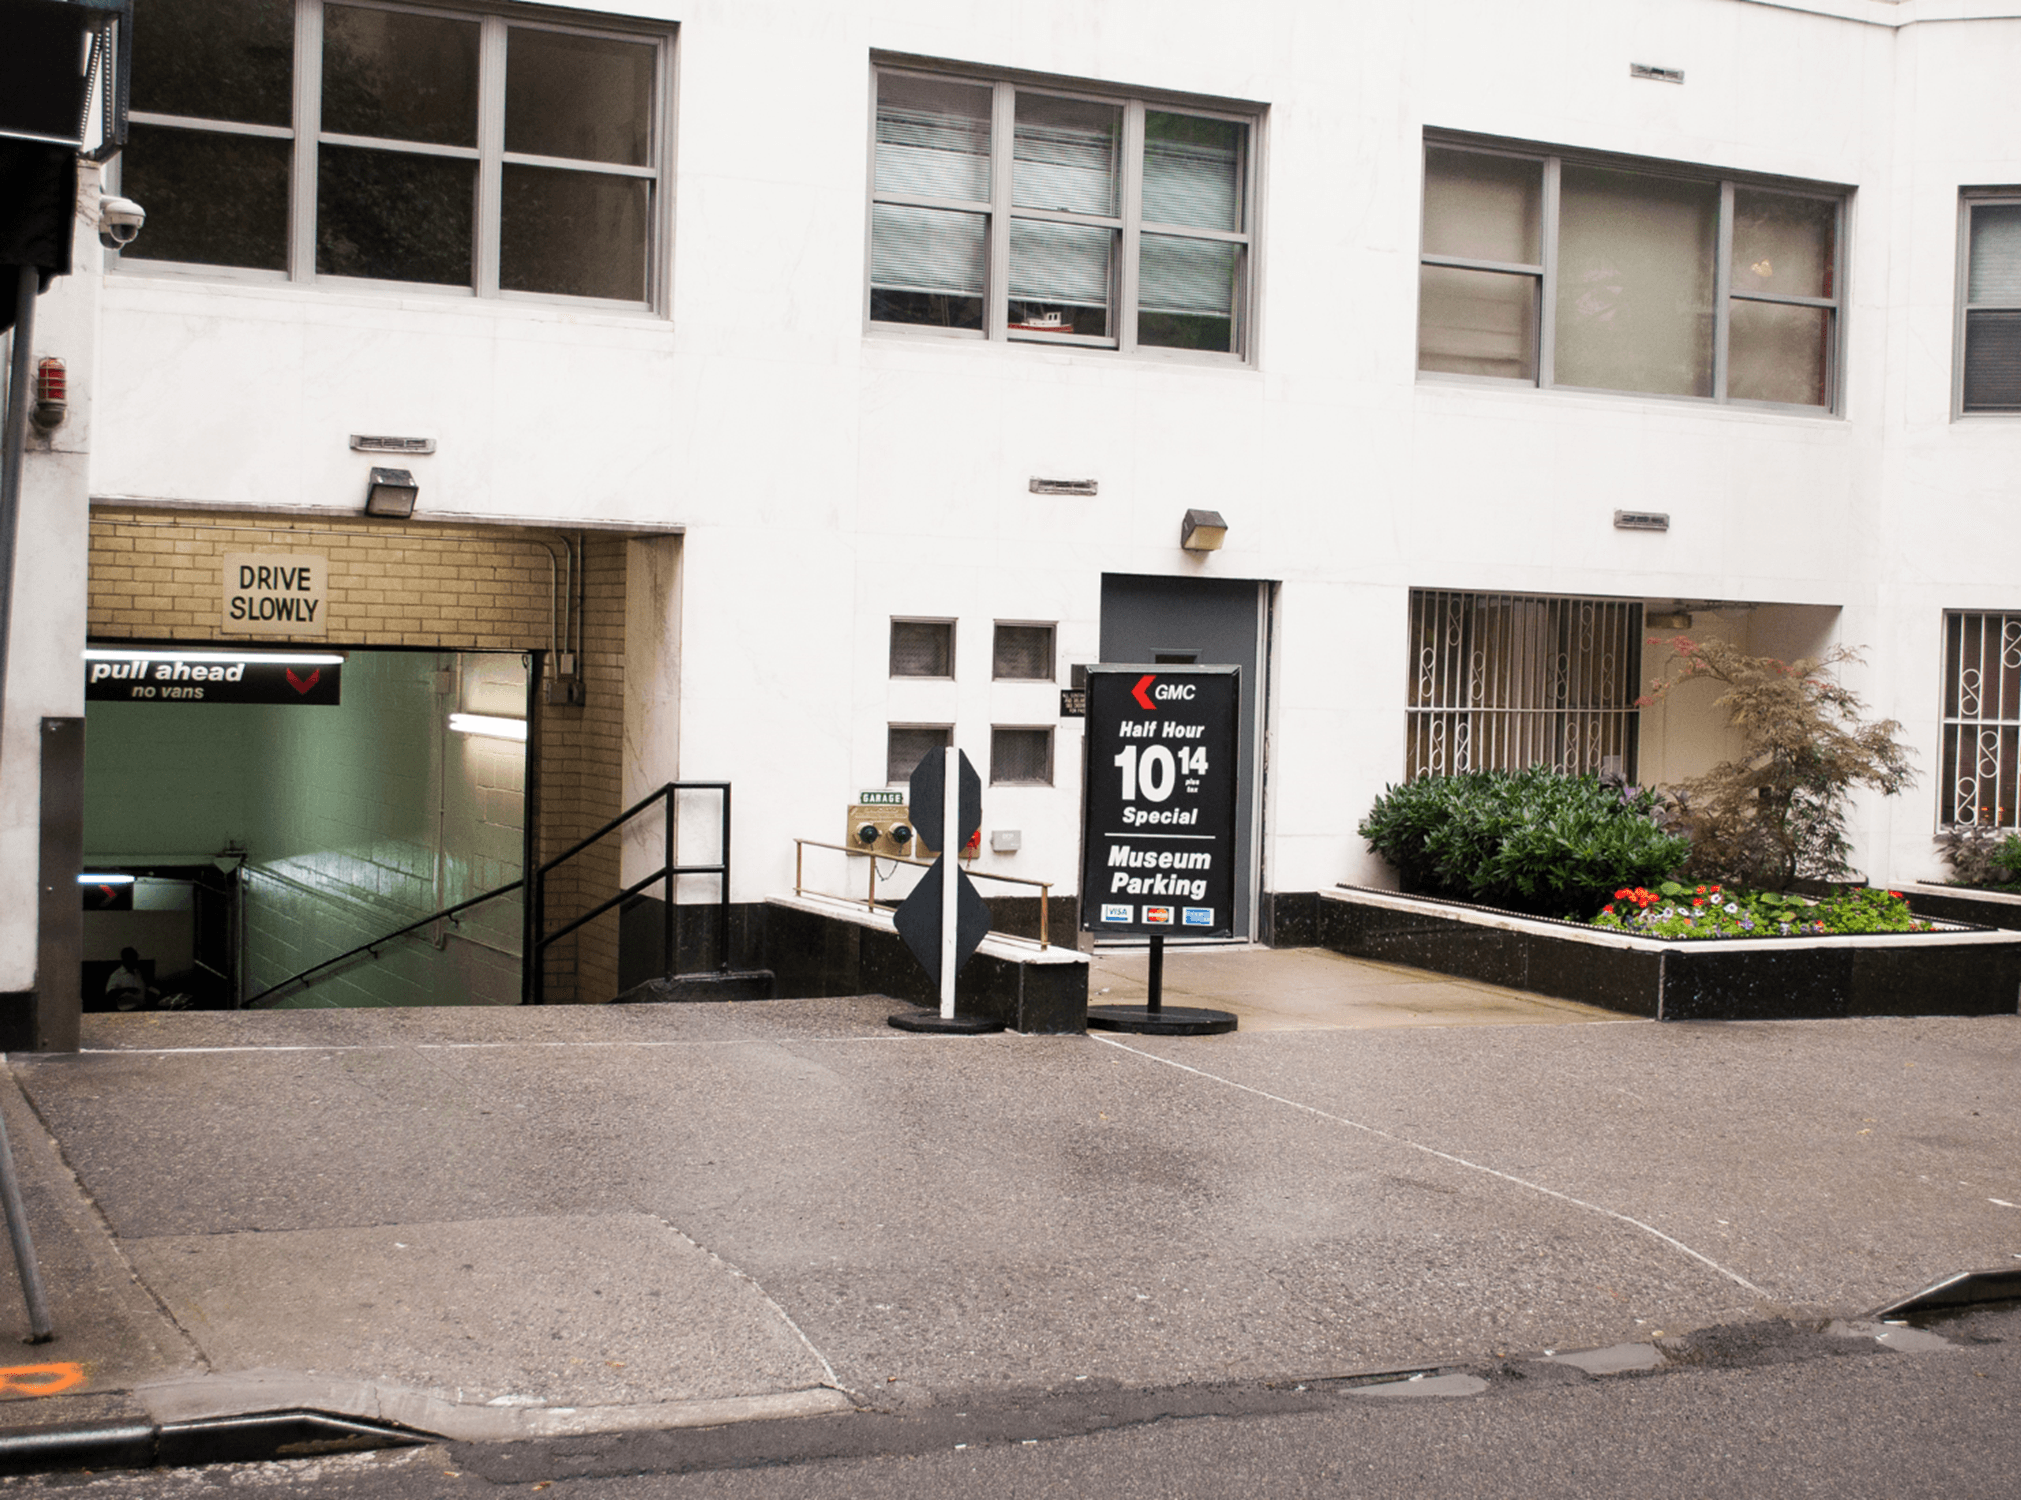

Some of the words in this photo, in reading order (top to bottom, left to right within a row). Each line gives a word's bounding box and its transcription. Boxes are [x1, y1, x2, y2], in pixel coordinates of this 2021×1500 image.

[239, 565, 311, 592] DRIVE
[229, 596, 318, 622] SLOWLY
[90, 660, 150, 684] pull
[155, 661, 245, 682] ahead
[131, 685, 157, 699] no
[160, 686, 205, 699] vans
[1154, 684, 1196, 701] GMC
[1119, 720, 1158, 738] Half
[1161, 721, 1205, 739] Hour
[1114, 744, 1176, 802] 10
[1177, 746, 1209, 776] 14
[1185, 778, 1200, 786] plus
[863, 794, 901, 803] GARAGE
[1186, 785, 1199, 793] tax
[1121, 806, 1199, 827] Special
[1107, 844, 1212, 870] Museum
[1110, 871, 1208, 901] Parking
[1108, 907, 1128, 916] VISA
